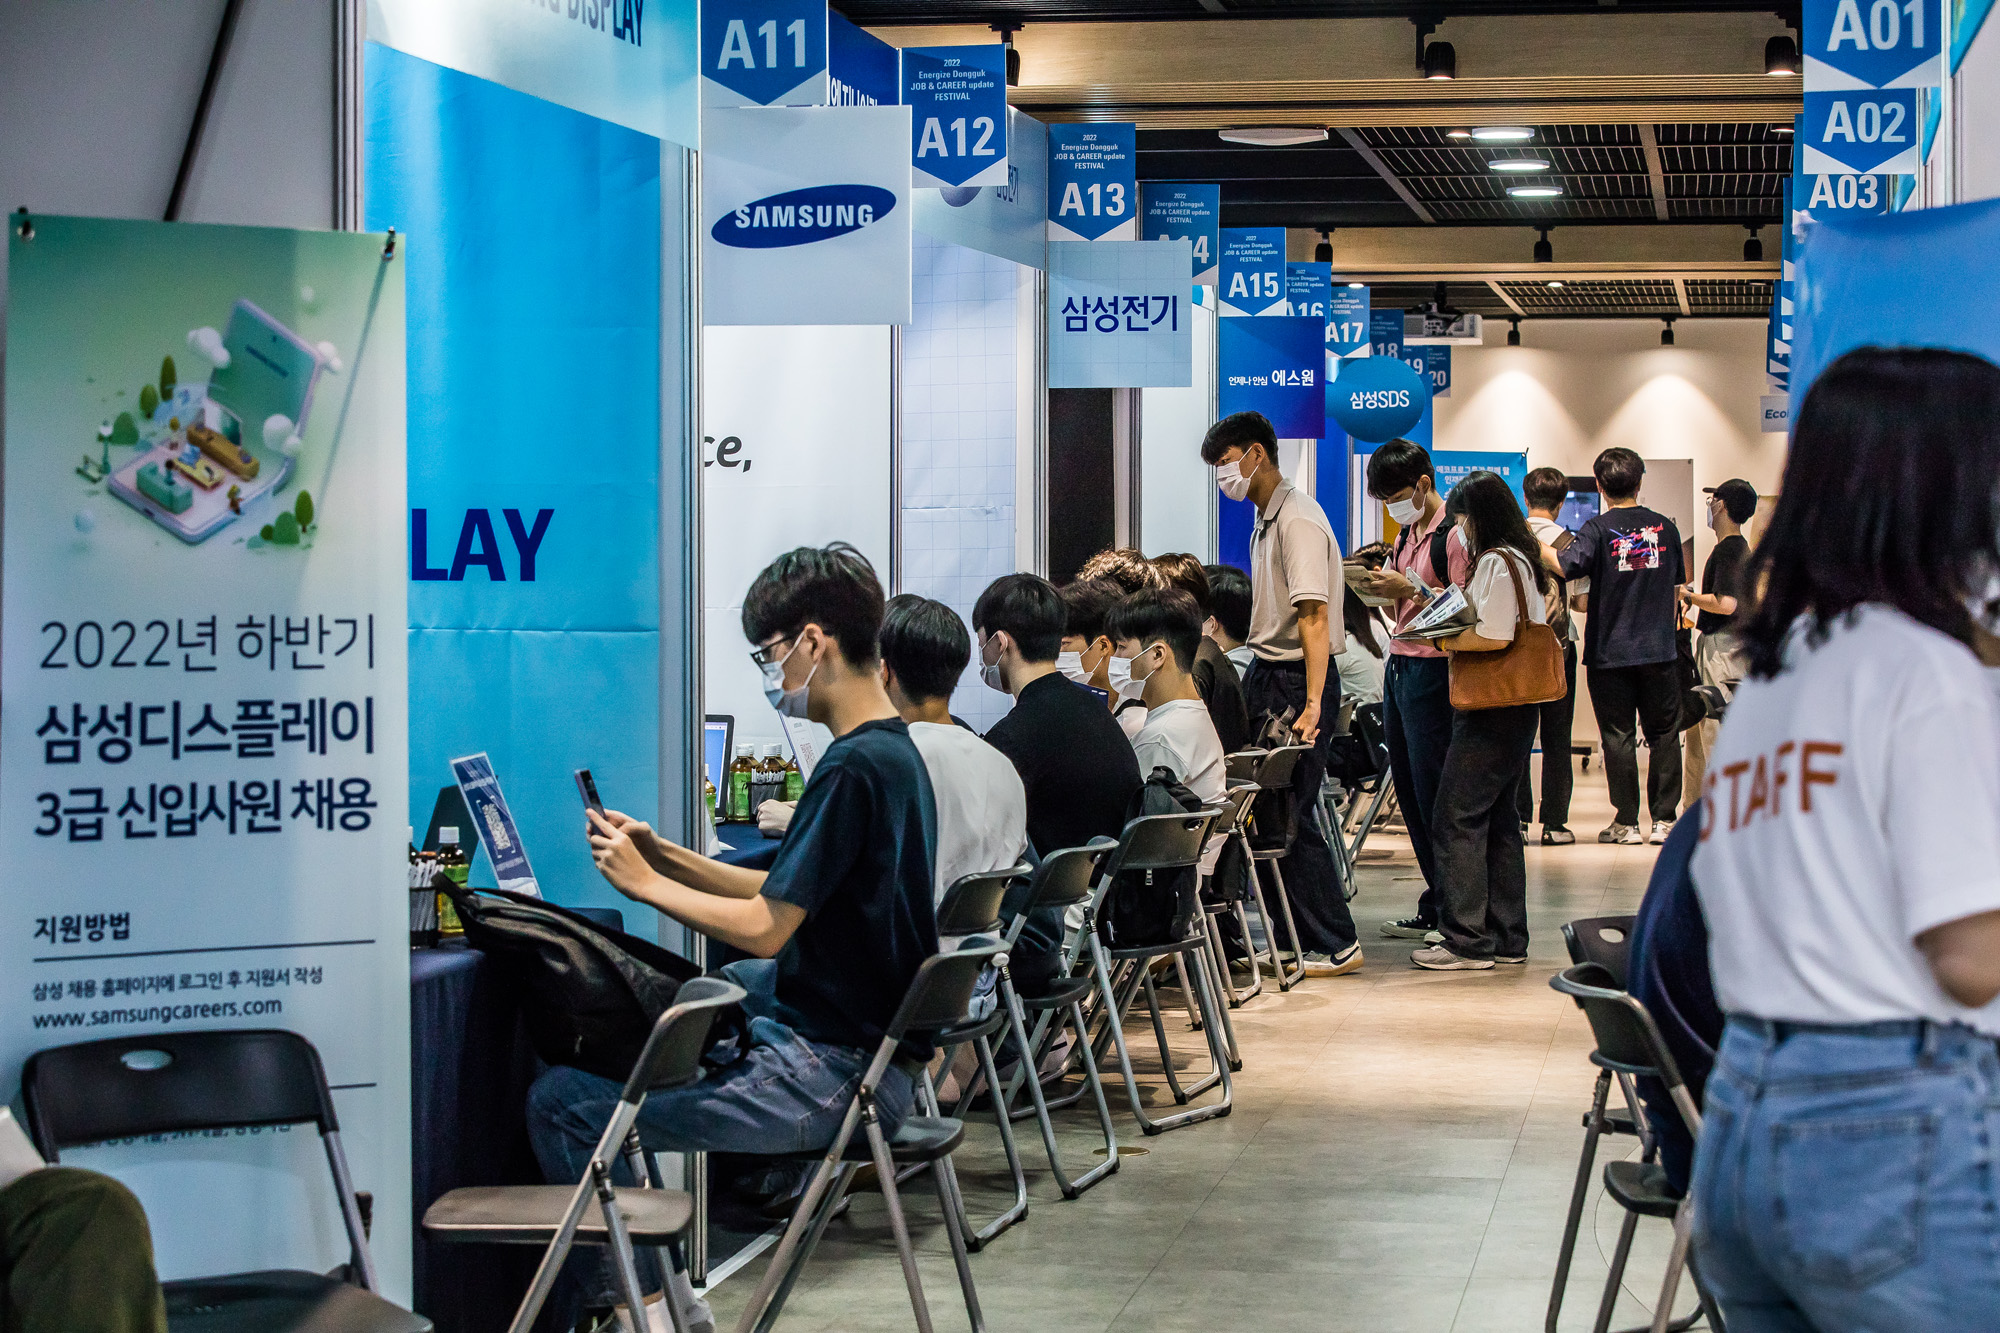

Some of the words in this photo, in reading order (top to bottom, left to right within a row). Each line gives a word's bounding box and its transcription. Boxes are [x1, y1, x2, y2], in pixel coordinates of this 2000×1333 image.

[1826, 0, 1925, 51] A01
[717, 19, 806, 70] A11
[918, 70, 951, 80] Energize
[952, 69, 986, 79] Dongguk
[943, 59, 961, 67] 2022
[910, 82, 927, 91] JOB
[928, 82, 935, 90] &
[936, 81, 967, 90] CAREER
[968, 80, 994, 91] update
[934, 92, 971, 101] FESTIVAL
[1822, 101, 1906, 143] A02
[917, 116, 995, 158] A12
[1061, 143, 1089, 152] Energize
[1090, 143, 1119, 152] Dongguk
[1082, 134, 1097, 142] 2022
[1074, 162, 1105, 170] FESTIVAL
[1076, 152, 1103, 160] CAREER
[1103, 153, 1126, 161] update
[1058, 182, 1126, 216] A13
[1808, 174, 1879, 209] A03
[735, 204, 874, 229] SAMSUNG
[1168, 208, 1191, 216] CAREER
[1228, 272, 1279, 298] A15
[1061, 295, 1177, 332] 삼성전기
[1325, 322, 1364, 343] A17
[1369, 342, 1398, 359] 18
[1228, 376, 1252, 387] 언제나
[1252, 376, 1268, 386] 안심
[1271, 369, 1315, 387] 에스원
[1349, 389, 1410, 410] 삼성SDS
[1765, 409, 1789, 420] Eco
[40, 615, 217, 672] 2022년
[236, 614, 374, 671] 하반기
[36, 696, 374, 765] 삼성디스플레이
[1700, 740, 1844, 844] STAFF
[35, 787, 109, 842] 3급
[117, 778, 282, 839] 신입사원
[291, 777, 378, 832] 채용
[34, 912, 131, 944] 지원방법
[32, 981, 63, 1001] 삼성
[67, 979, 97, 999] 채용
[102, 974, 175, 998] 홈페이지에
[178, 971, 223, 990] 로그인
[226, 970, 242, 990] 후
[246, 968, 290, 988] 지원서
[294, 966, 323, 985] 작성
[33, 997, 282, 1029] www.samsungcareers.com
